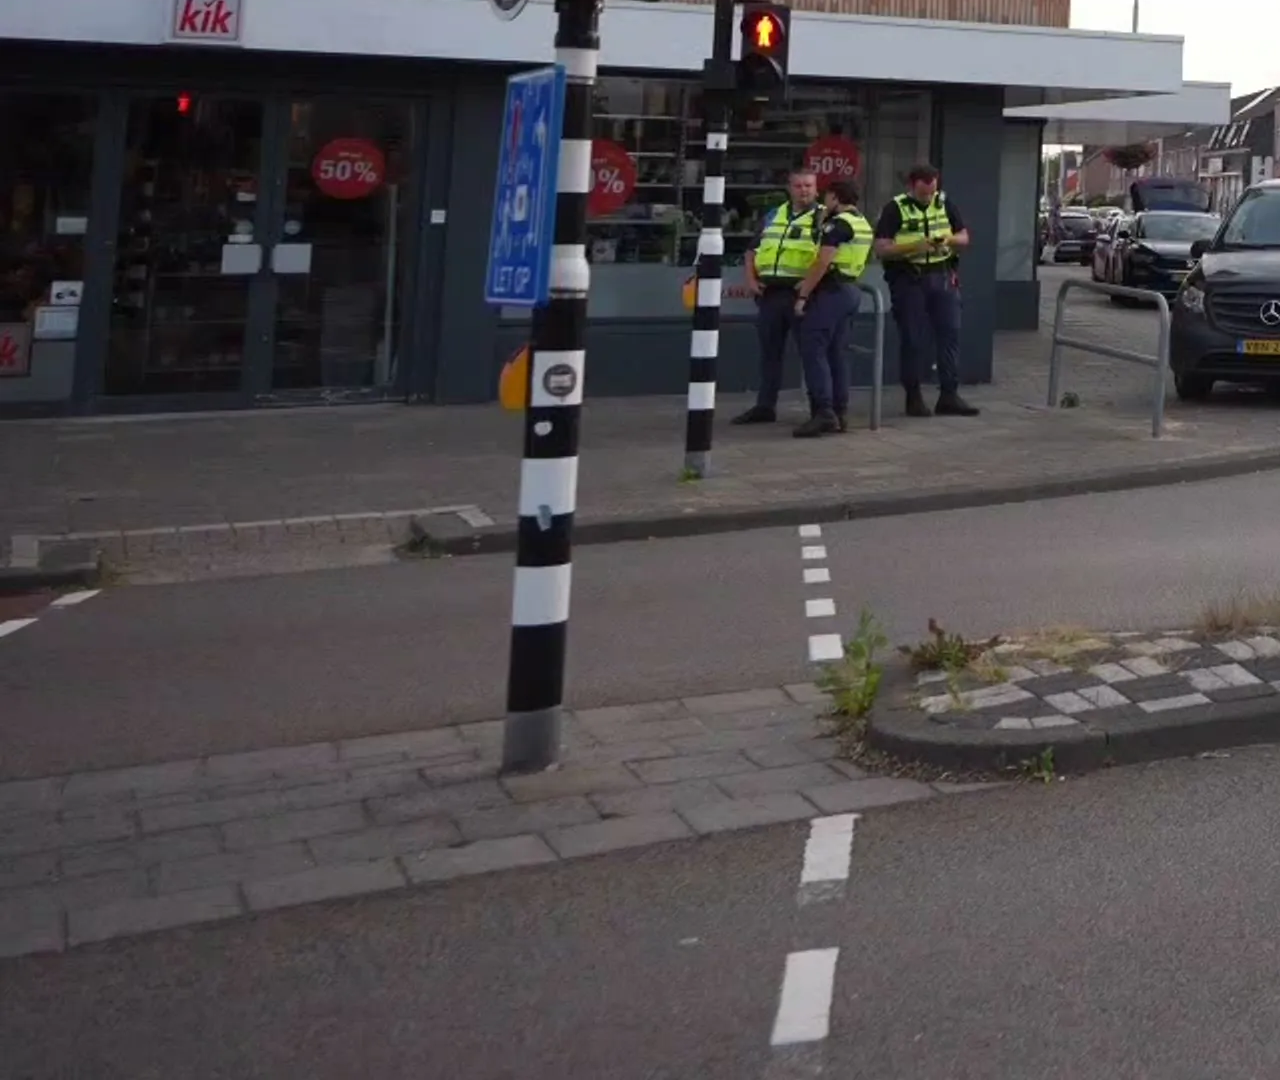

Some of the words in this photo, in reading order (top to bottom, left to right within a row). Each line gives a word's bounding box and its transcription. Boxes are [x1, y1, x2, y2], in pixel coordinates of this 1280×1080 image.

[319, 160, 377, 183] 50%
[809, 156, 854, 175] 50%
[493, 265, 514, 294] LET
[514, 265, 532, 295] OP
